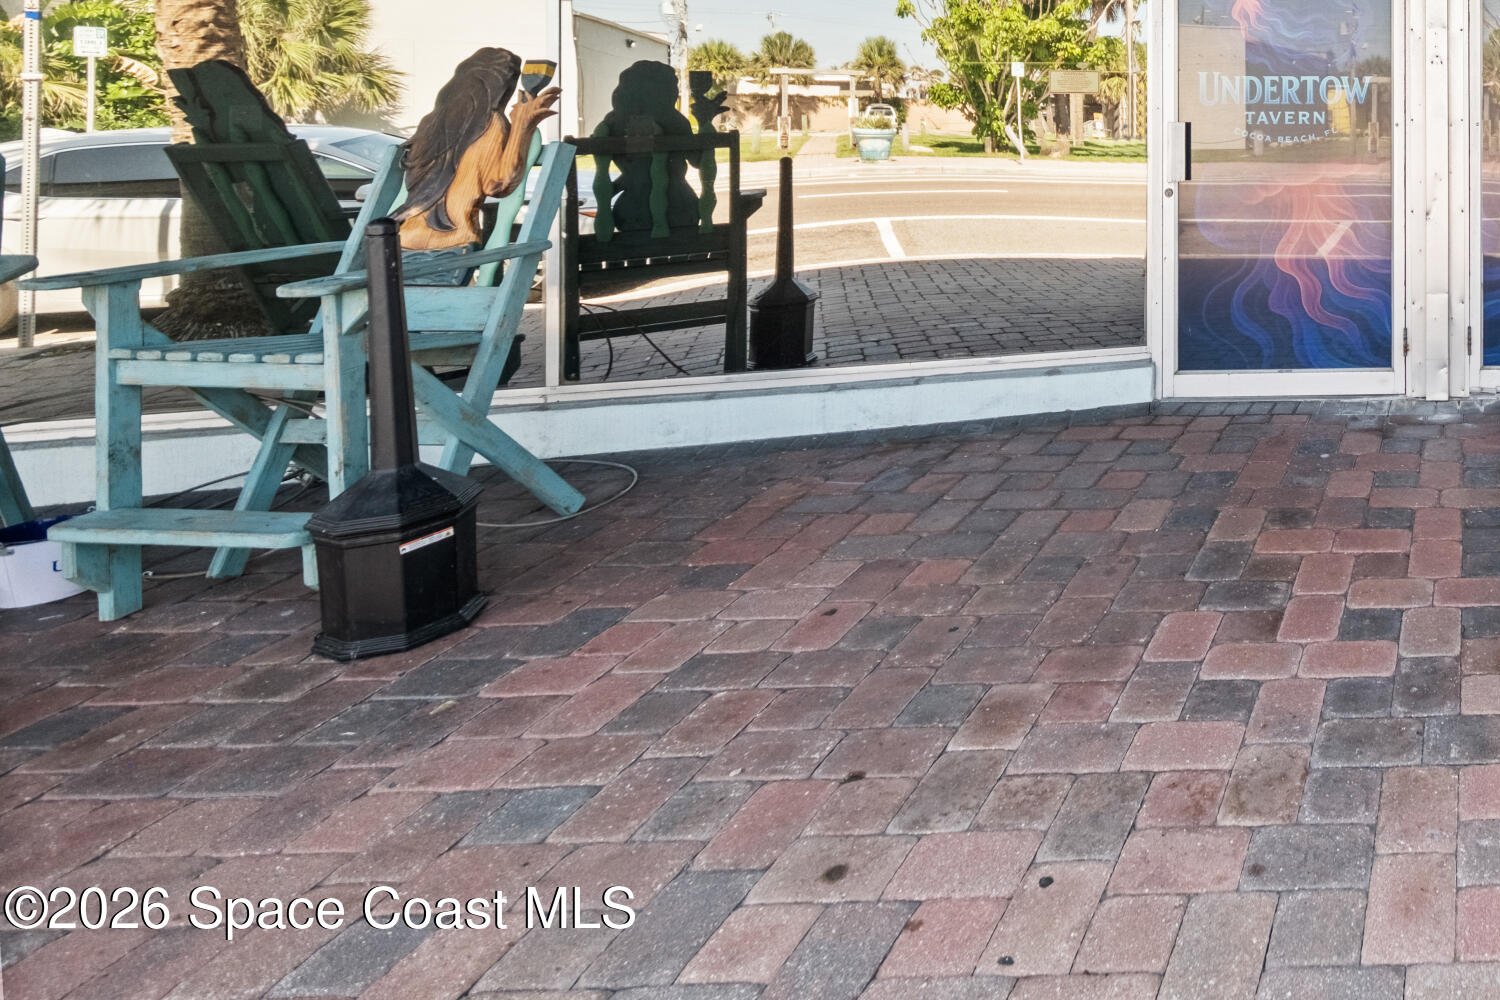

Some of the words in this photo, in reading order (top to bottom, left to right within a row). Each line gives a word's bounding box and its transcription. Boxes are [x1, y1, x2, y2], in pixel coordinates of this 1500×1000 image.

[1198, 71, 1373, 107] UNDERTOW
[1246, 111, 1326, 125] TAVERN
[1234, 127, 1271, 143] COCOA
[1277, 133, 1320, 143] BEACH,
[1324, 127, 1337, 137] FL
